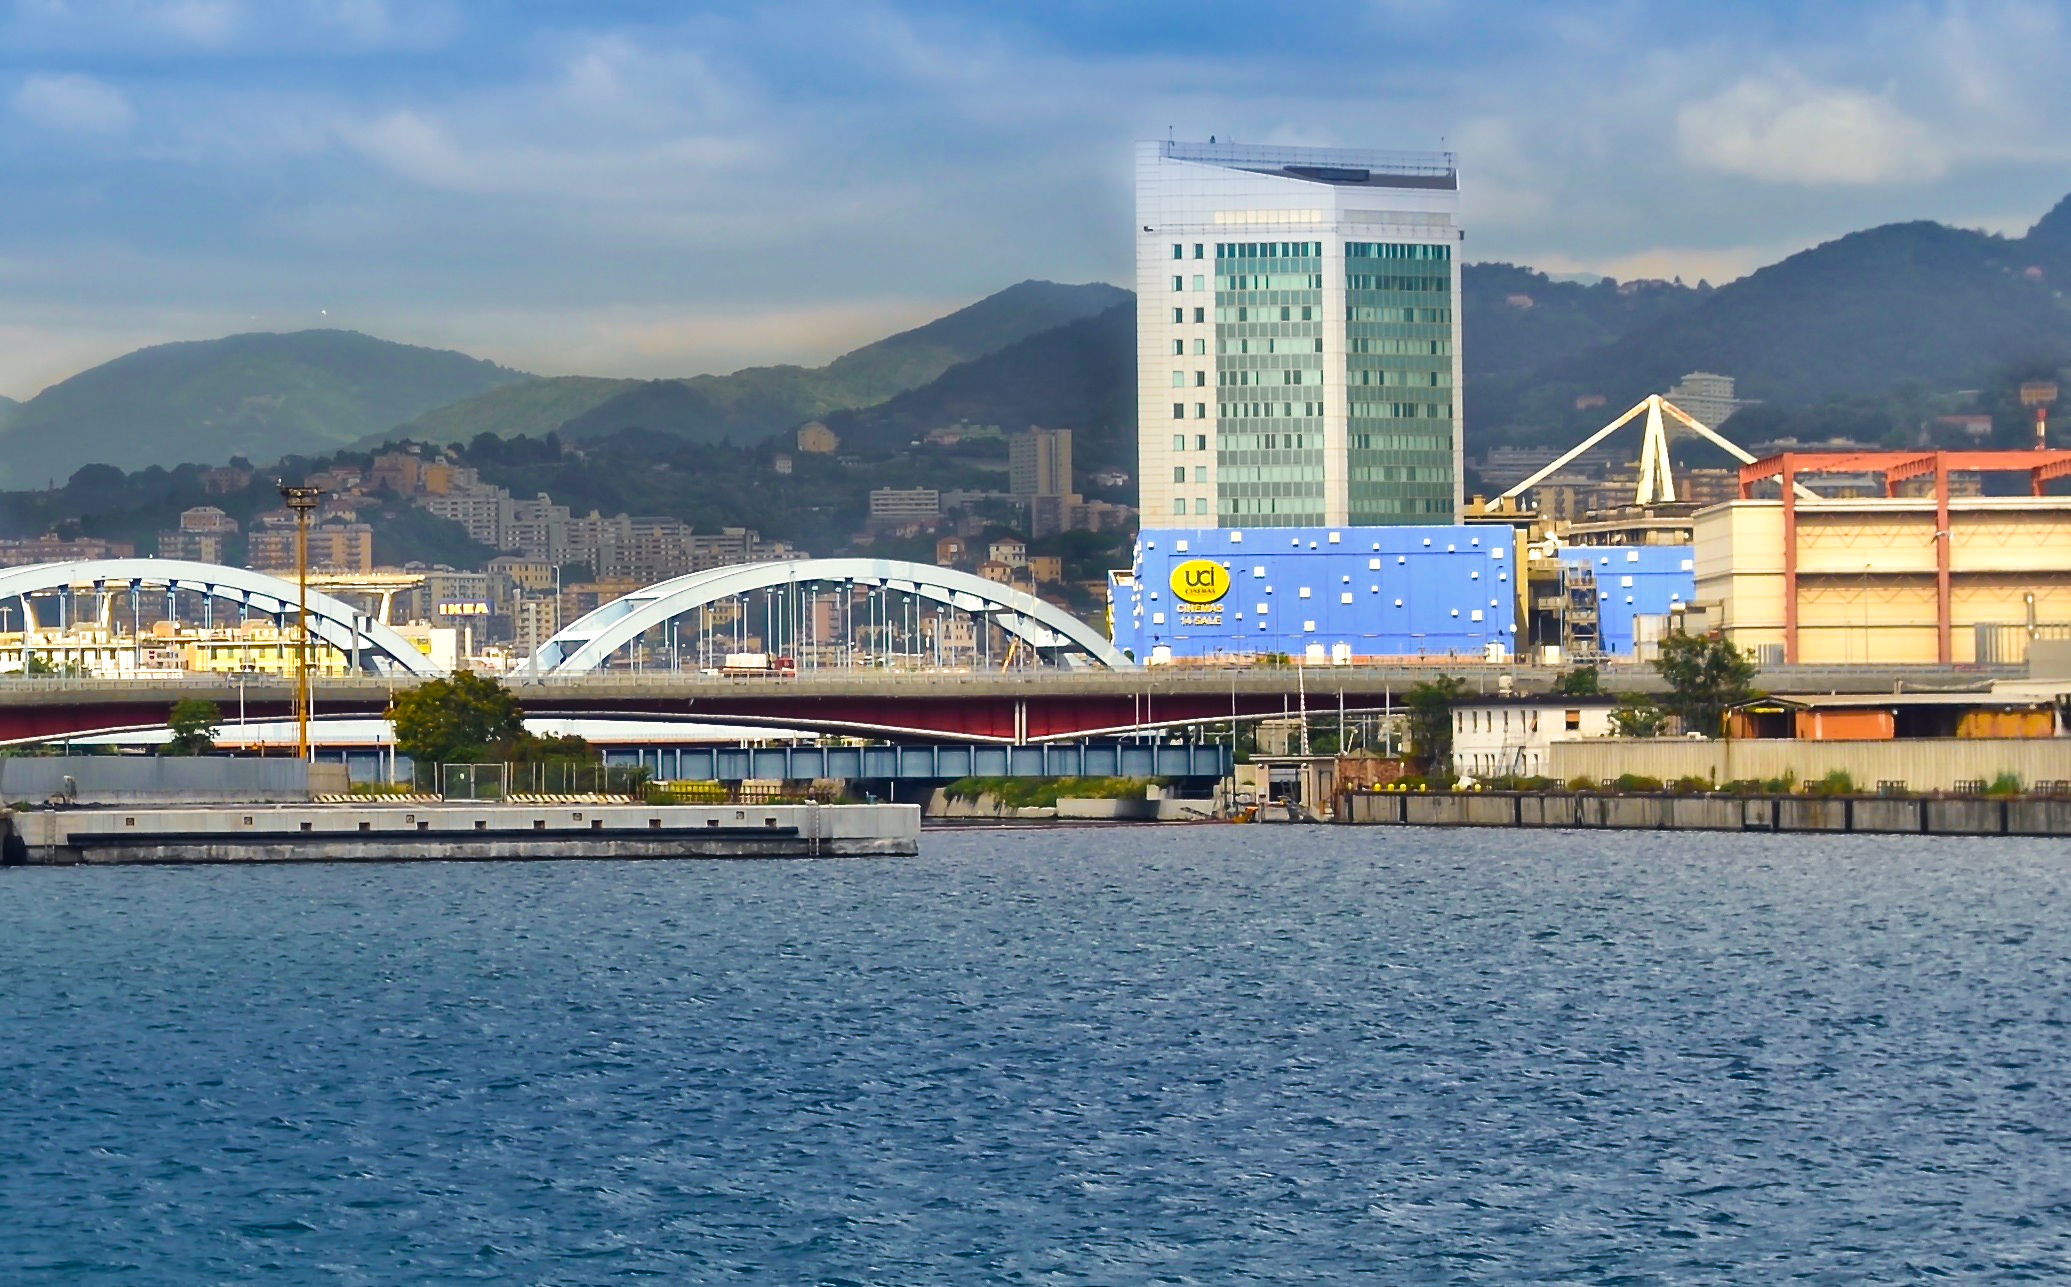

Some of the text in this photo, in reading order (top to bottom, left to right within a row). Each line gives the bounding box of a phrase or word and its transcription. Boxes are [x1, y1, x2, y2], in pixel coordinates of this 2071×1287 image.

[1185, 566, 1215, 587] uci
[439, 602, 489, 615] IKEA
[1177, 603, 1224, 613] CINEMAS
[1195, 616, 1222, 626] SALE
